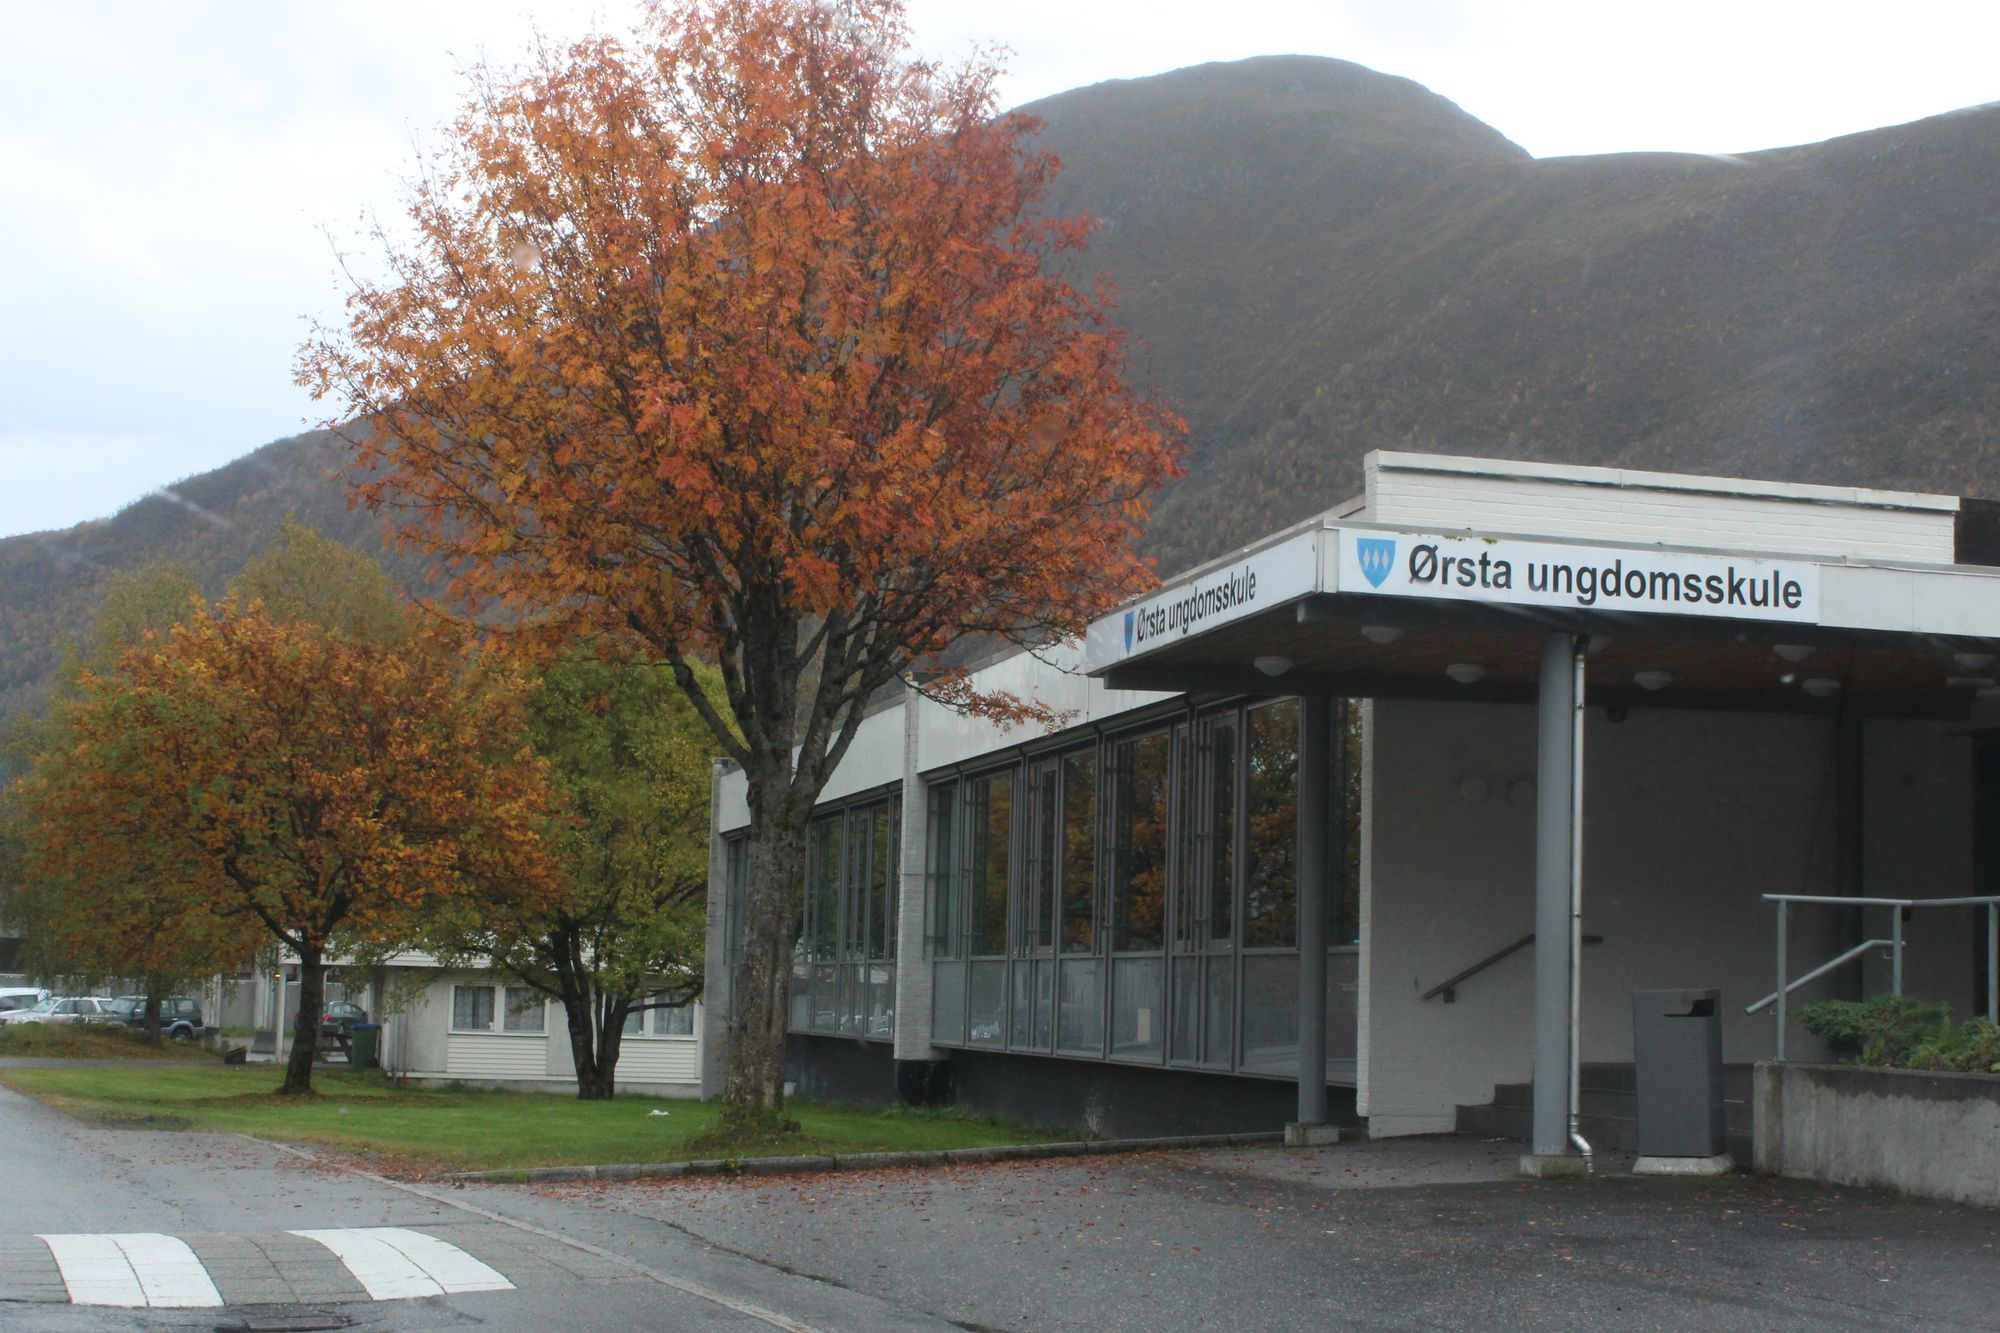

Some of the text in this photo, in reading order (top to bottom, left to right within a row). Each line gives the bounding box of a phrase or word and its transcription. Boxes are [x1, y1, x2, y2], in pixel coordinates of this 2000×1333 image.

[1137, 566, 1256, 643] Ørsta ungdomsskule
[1408, 544, 1803, 609] Ørsta ungdomsskule
